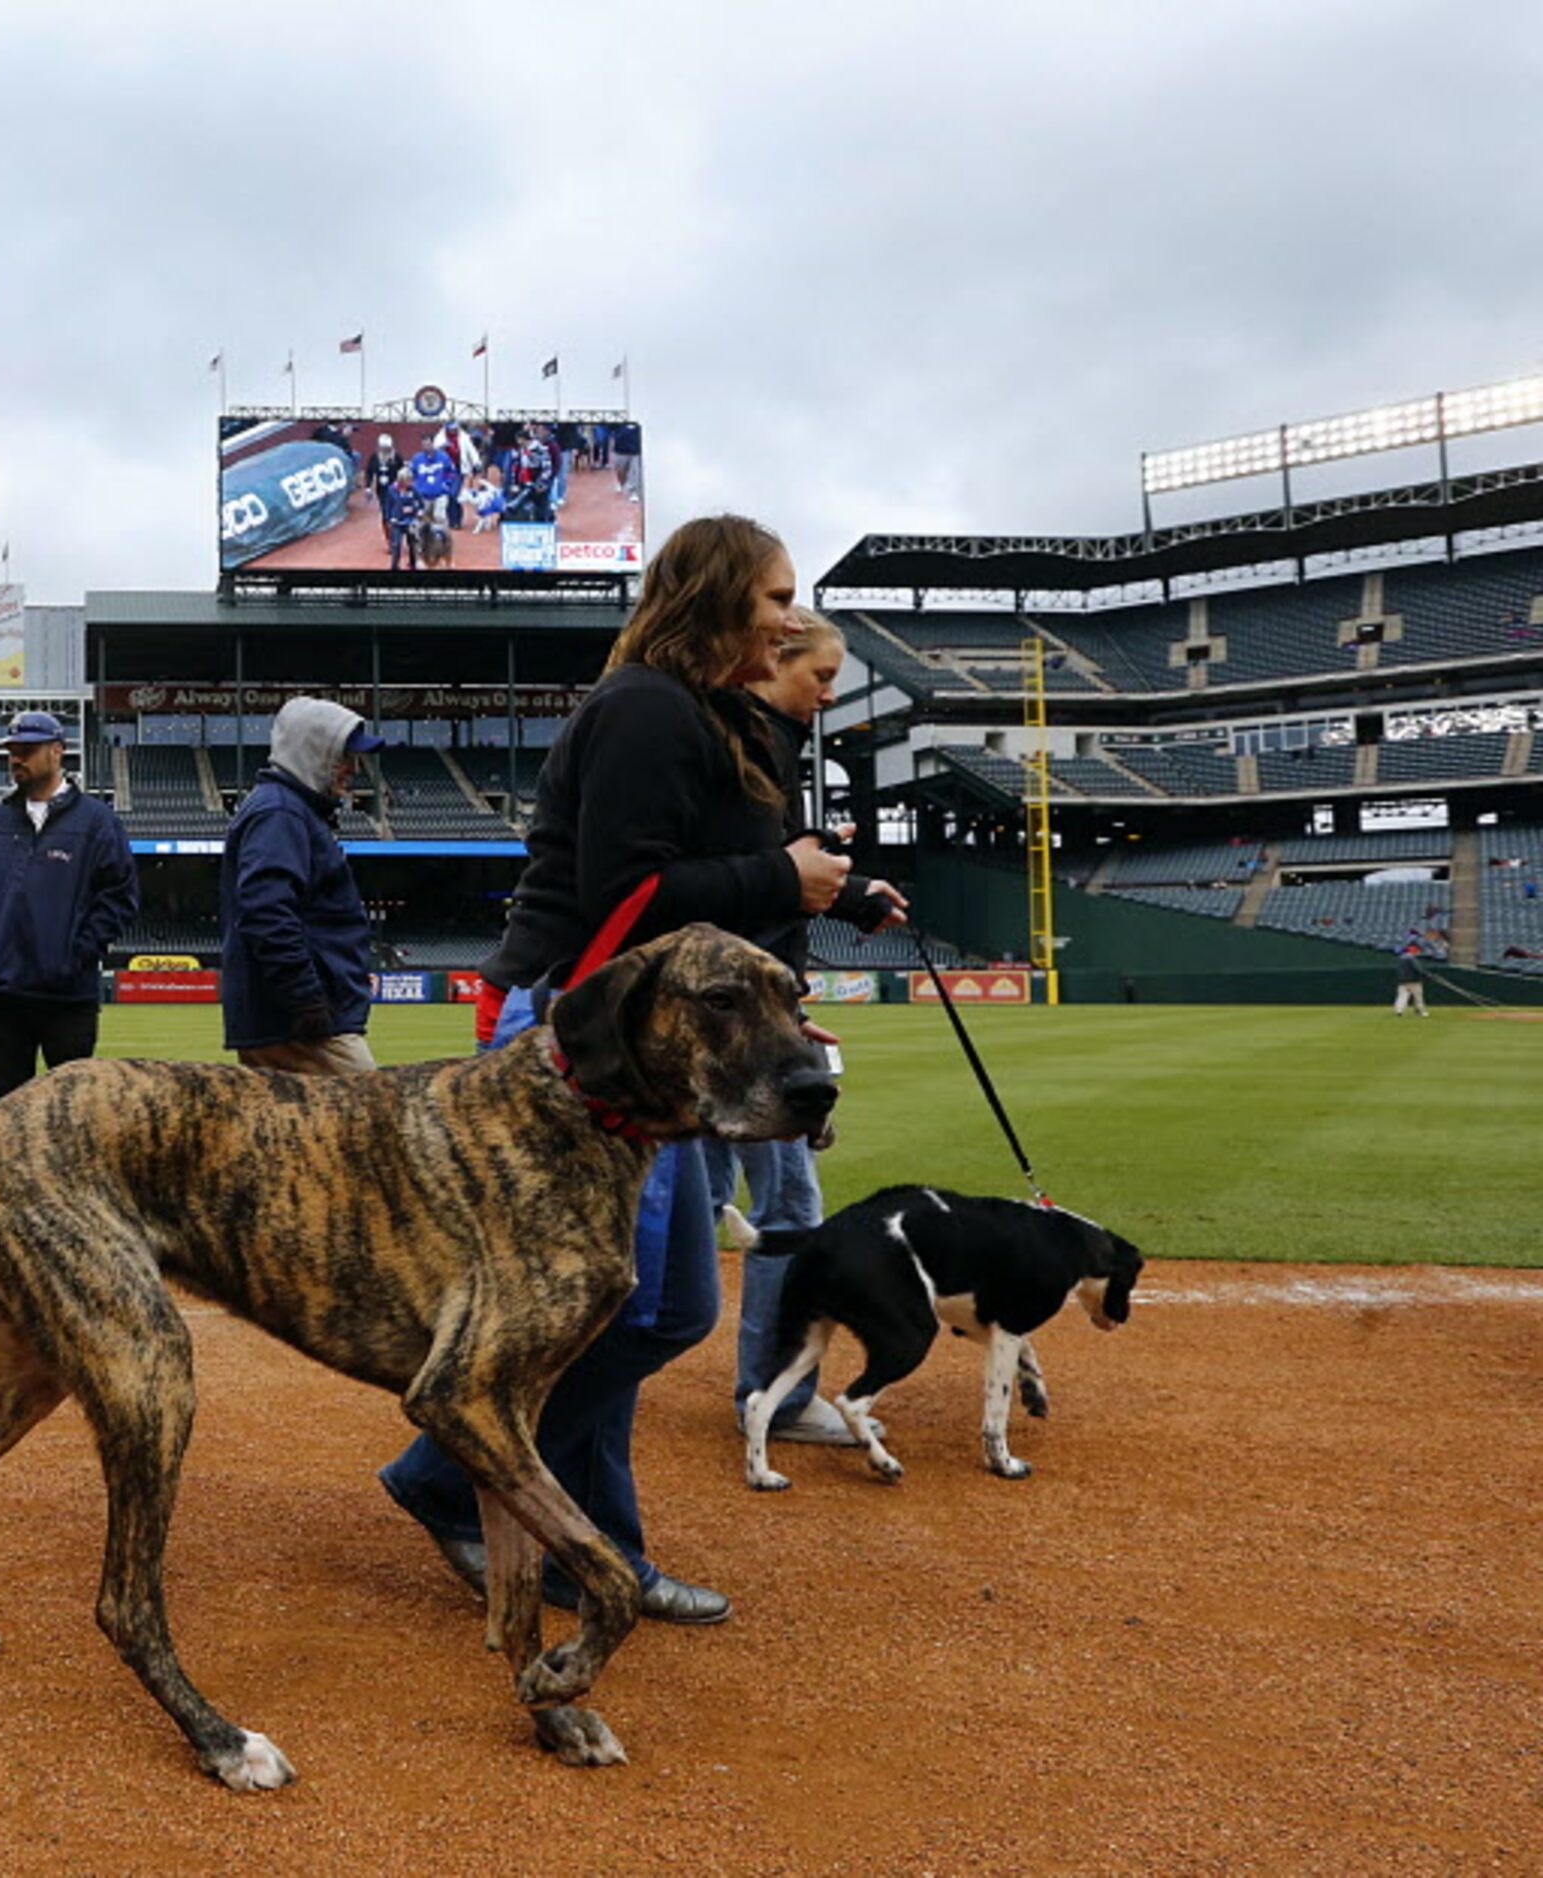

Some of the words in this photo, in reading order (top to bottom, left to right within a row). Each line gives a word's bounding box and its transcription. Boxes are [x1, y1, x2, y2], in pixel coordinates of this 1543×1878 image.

[222, 492, 269, 540] ICO
[560, 544, 615, 559] petco
[423, 690, 490, 709] Always
